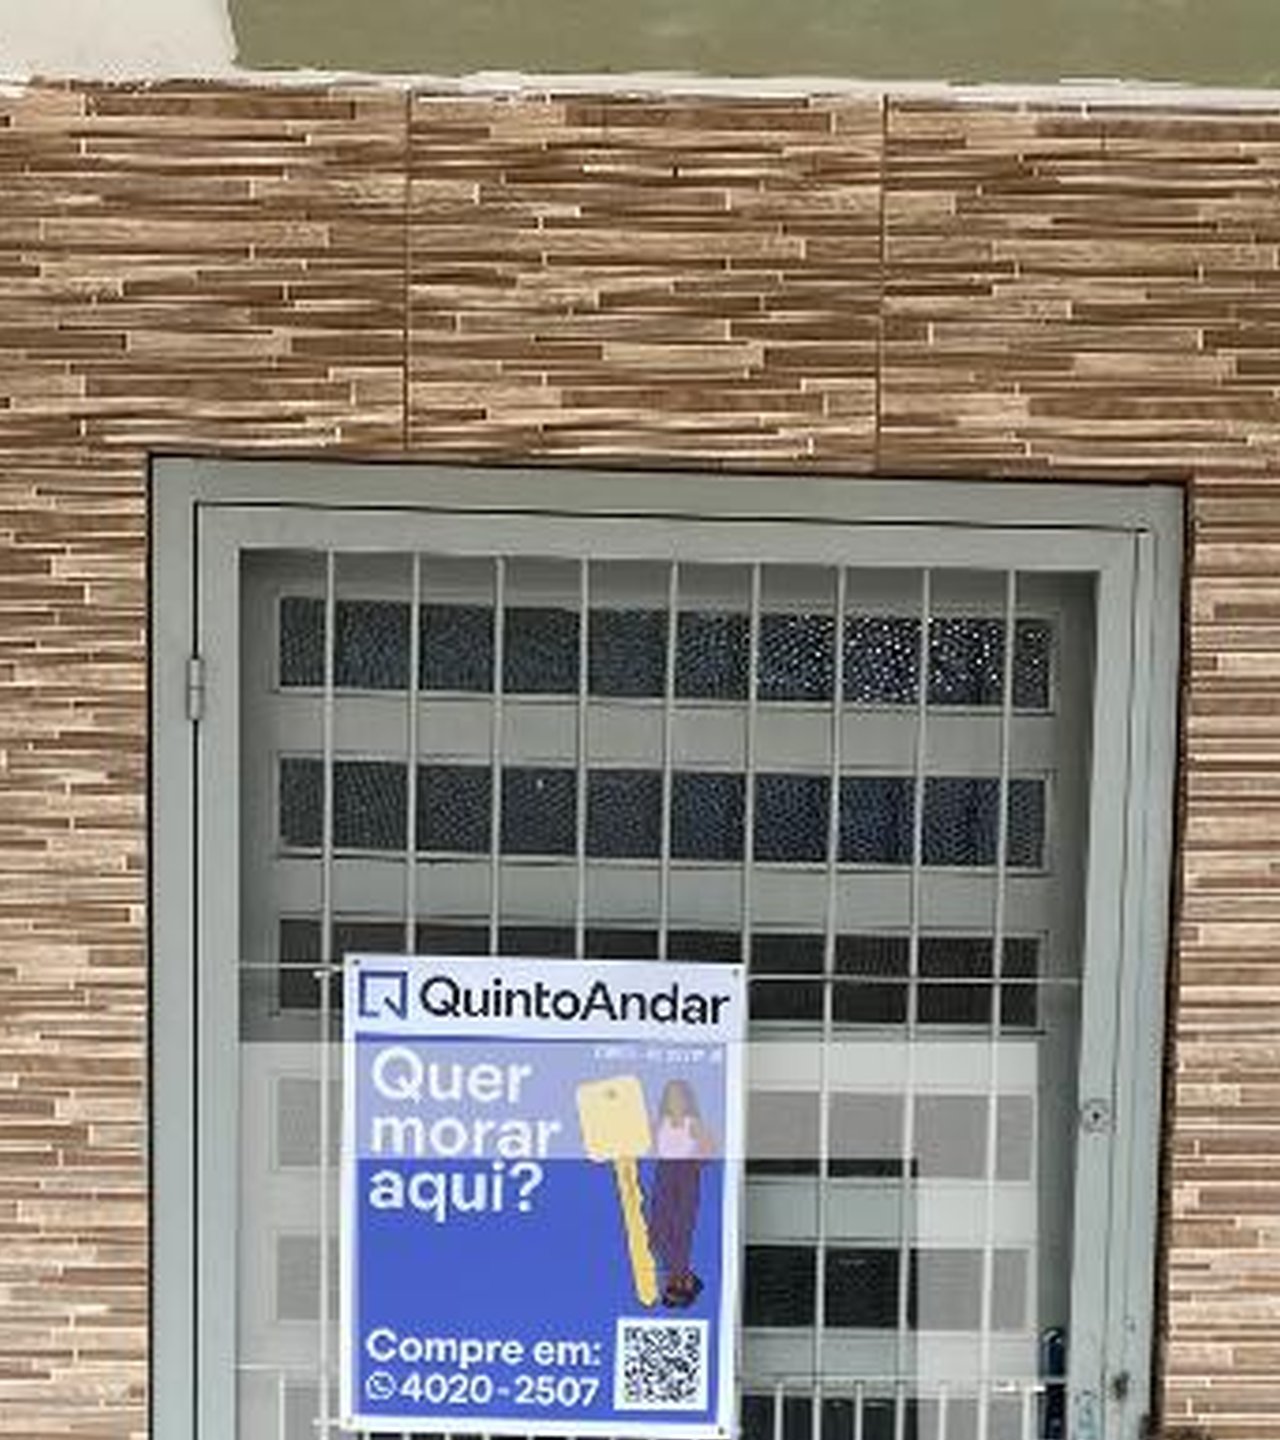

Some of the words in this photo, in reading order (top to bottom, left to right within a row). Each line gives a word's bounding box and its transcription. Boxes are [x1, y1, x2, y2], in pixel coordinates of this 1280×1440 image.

[419, 975, 730, 1025] QuintoAndar
[372, 1047, 533, 1104] Quer
[370, 1112, 563, 1158] morar
[369, 1160, 544, 1224] aqui?
[365, 1328, 525, 1370] Compre
[533, 1339, 601, 1366] em:
